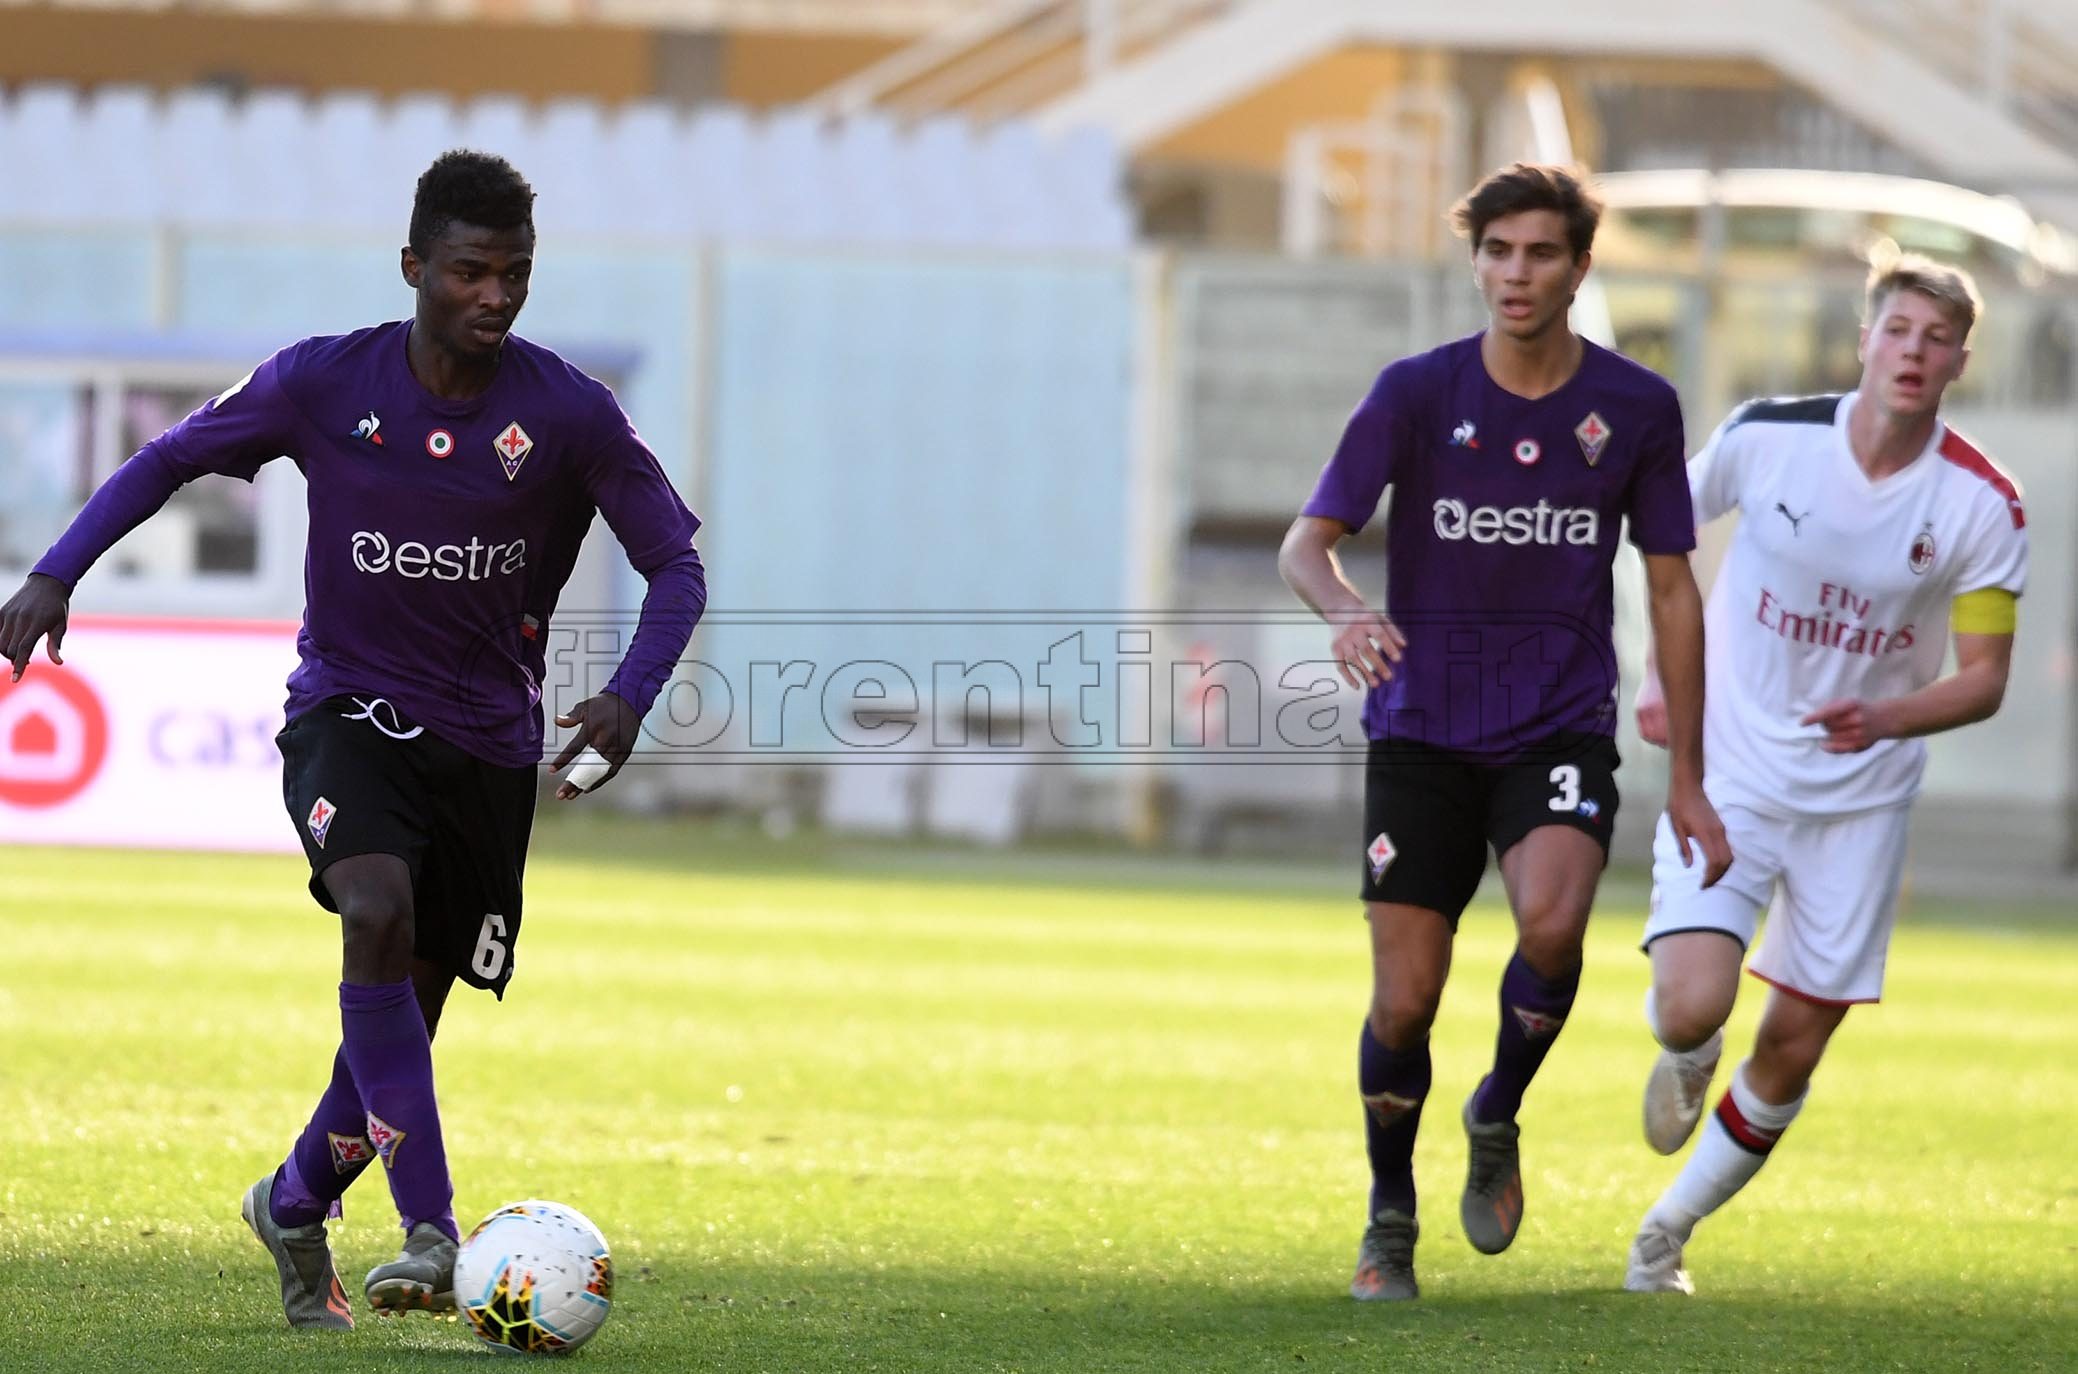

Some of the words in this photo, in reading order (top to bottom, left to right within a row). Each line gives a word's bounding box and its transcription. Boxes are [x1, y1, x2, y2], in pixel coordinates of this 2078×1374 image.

[1469, 499, 1598, 546] estra
[395, 537, 525, 580] estra
[1757, 588, 1915, 657] Emirates
[1819, 582, 1871, 619] Fly
[1548, 764, 1581, 812] 3
[472, 914, 507, 980] 6
